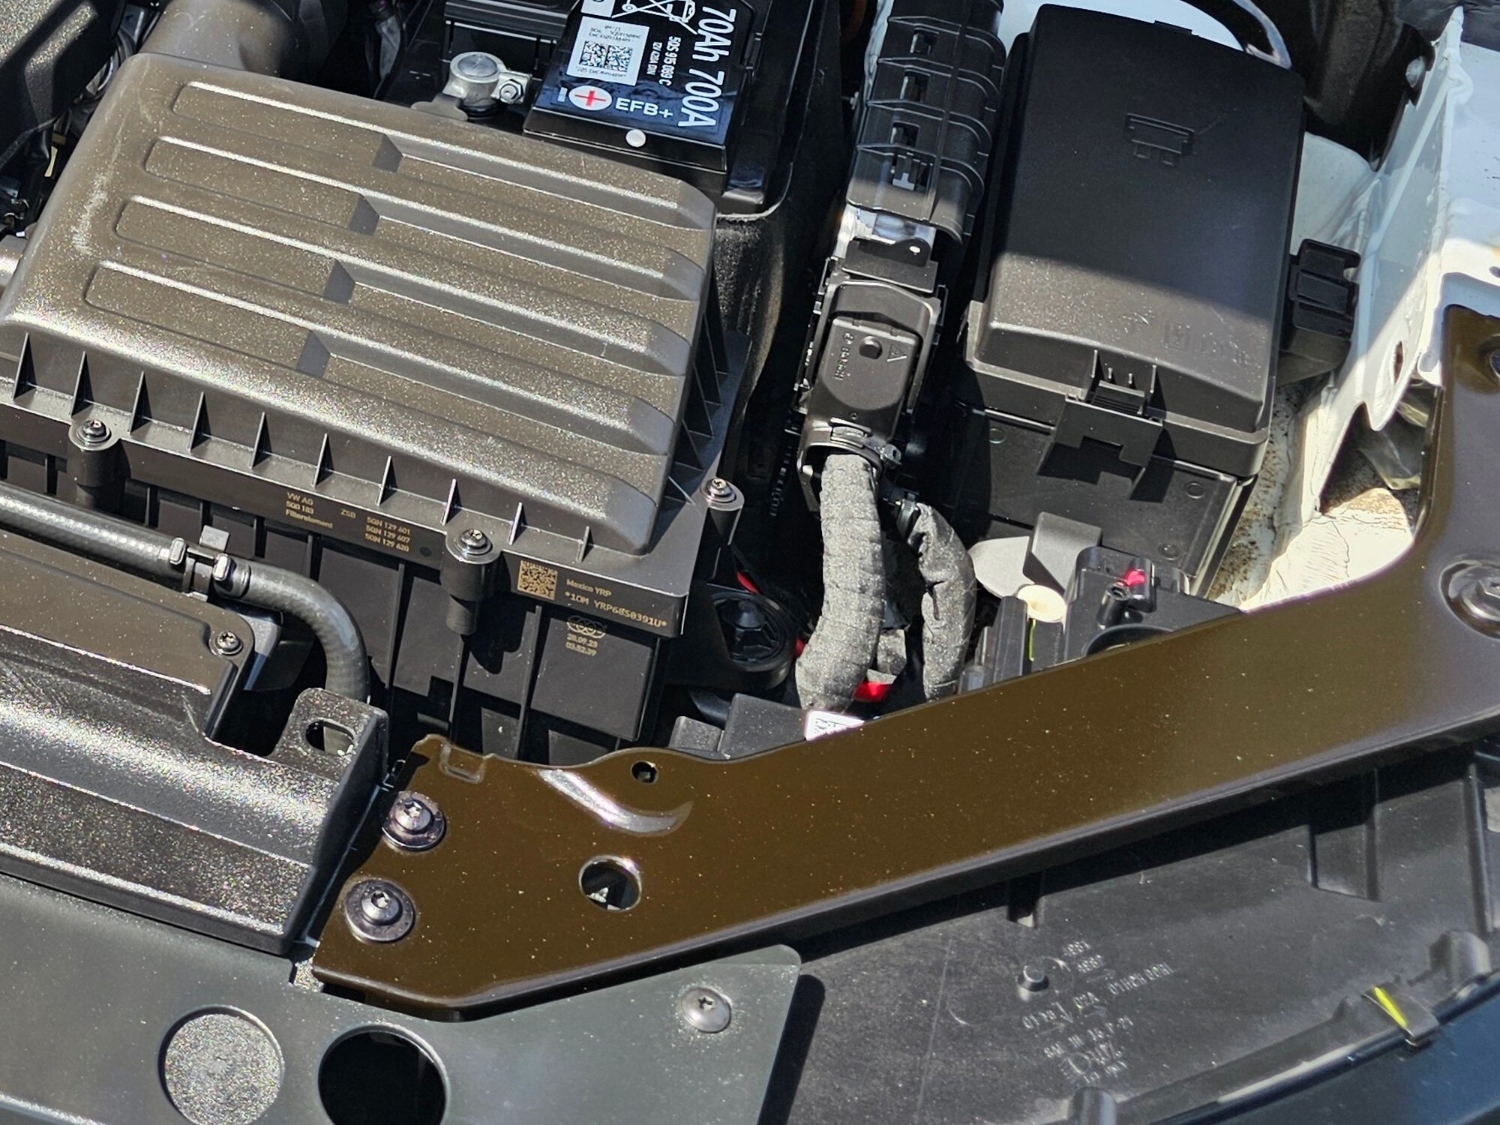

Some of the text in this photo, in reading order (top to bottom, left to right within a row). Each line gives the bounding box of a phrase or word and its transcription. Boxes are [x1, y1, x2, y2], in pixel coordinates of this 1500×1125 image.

[663, 51, 678, 65] 915
[678, 6, 737, 127] 70Ah 700A
[658, 78, 672, 86] C
[615, 97, 673, 118] EFB+
[286, 492, 314, 506] VW AG
[285, 508, 333, 529] Filterelement
[384, 521, 397, 531] 129
[383, 530, 396, 539] 129
[382, 538, 395, 548] 129
[566, 578, 612, 597] Mexico YRP
